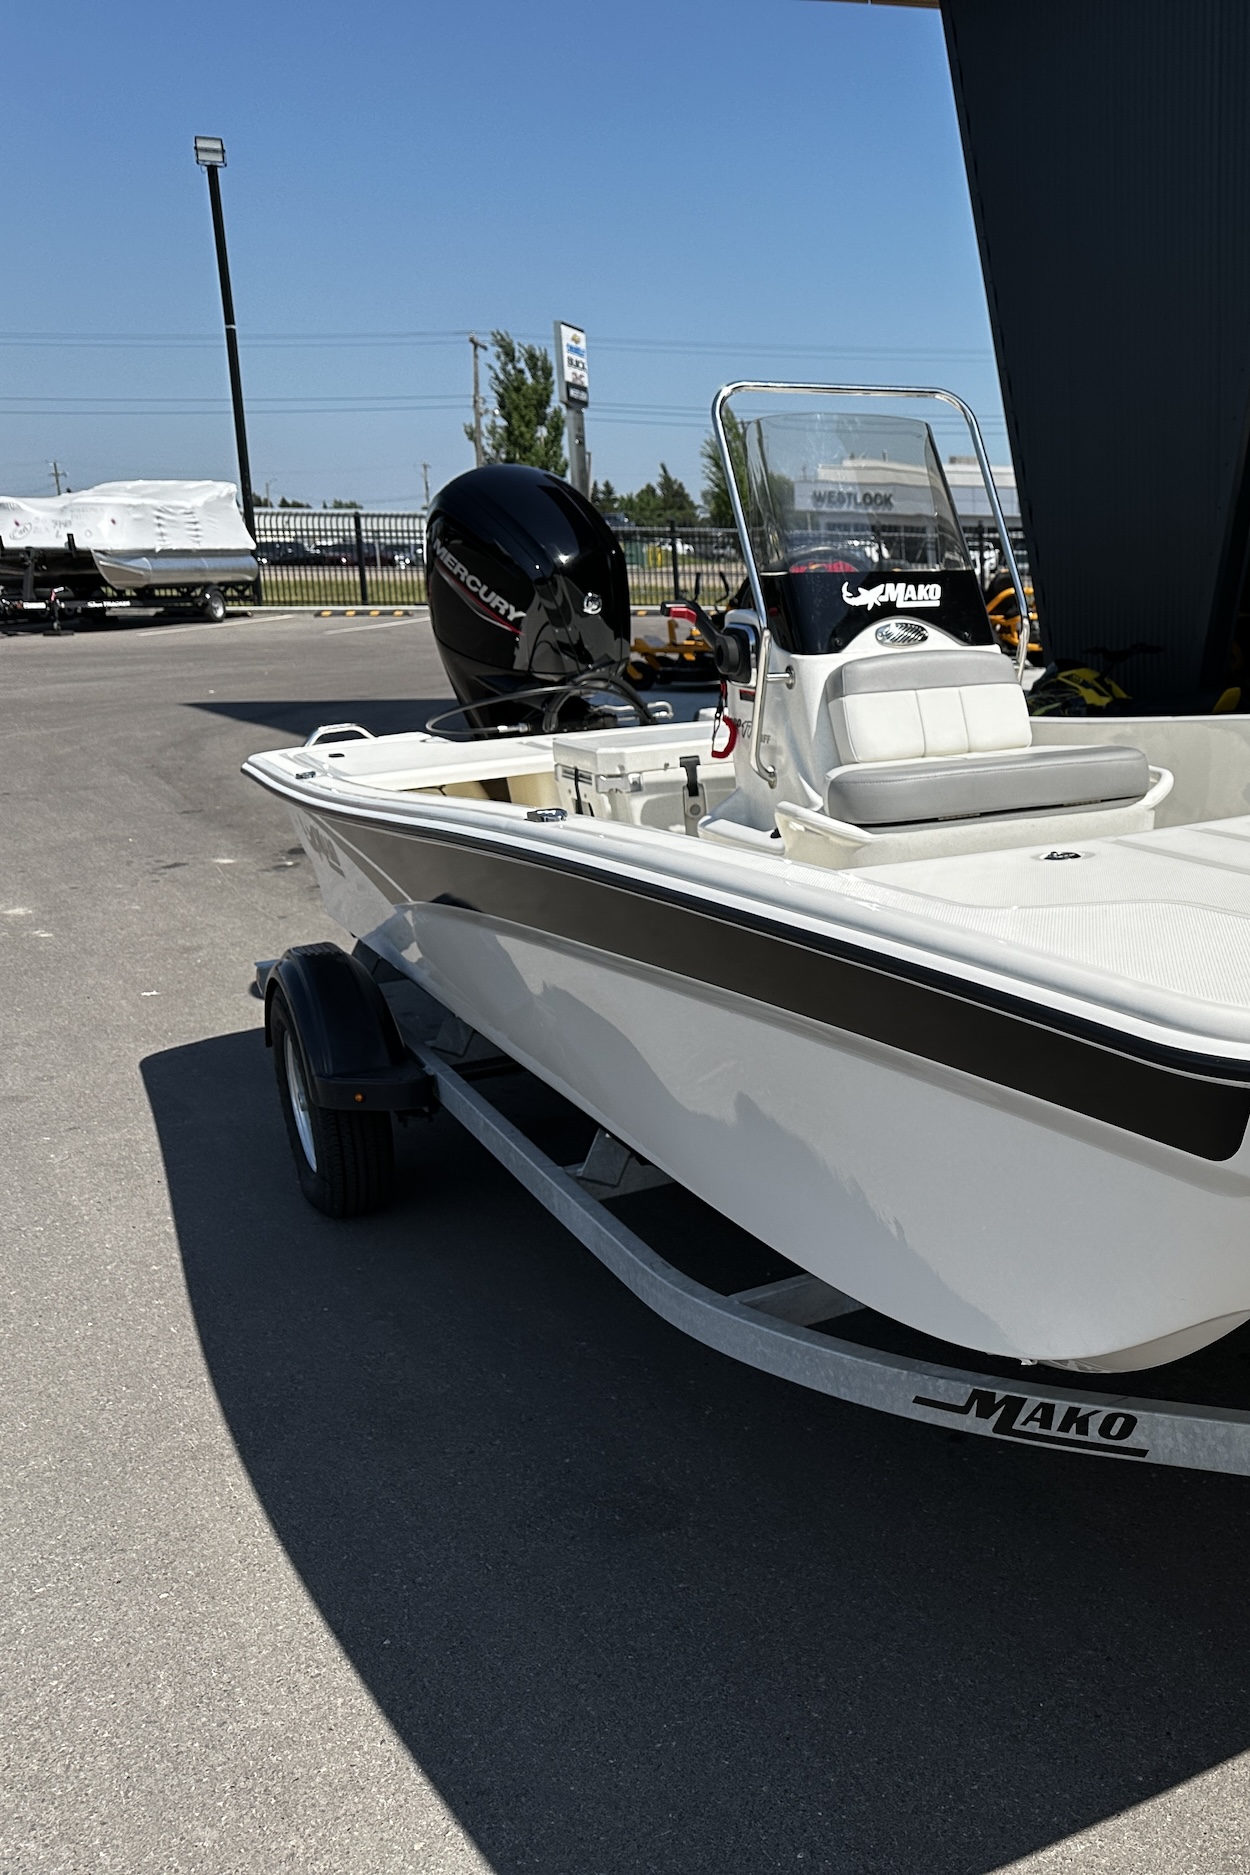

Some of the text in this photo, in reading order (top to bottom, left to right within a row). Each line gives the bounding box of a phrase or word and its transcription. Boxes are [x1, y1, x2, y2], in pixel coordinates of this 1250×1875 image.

[433, 538, 527, 622] MERCURY
[878, 583, 942, 608] MAKO
[912, 1388, 1149, 1458] MAKO
